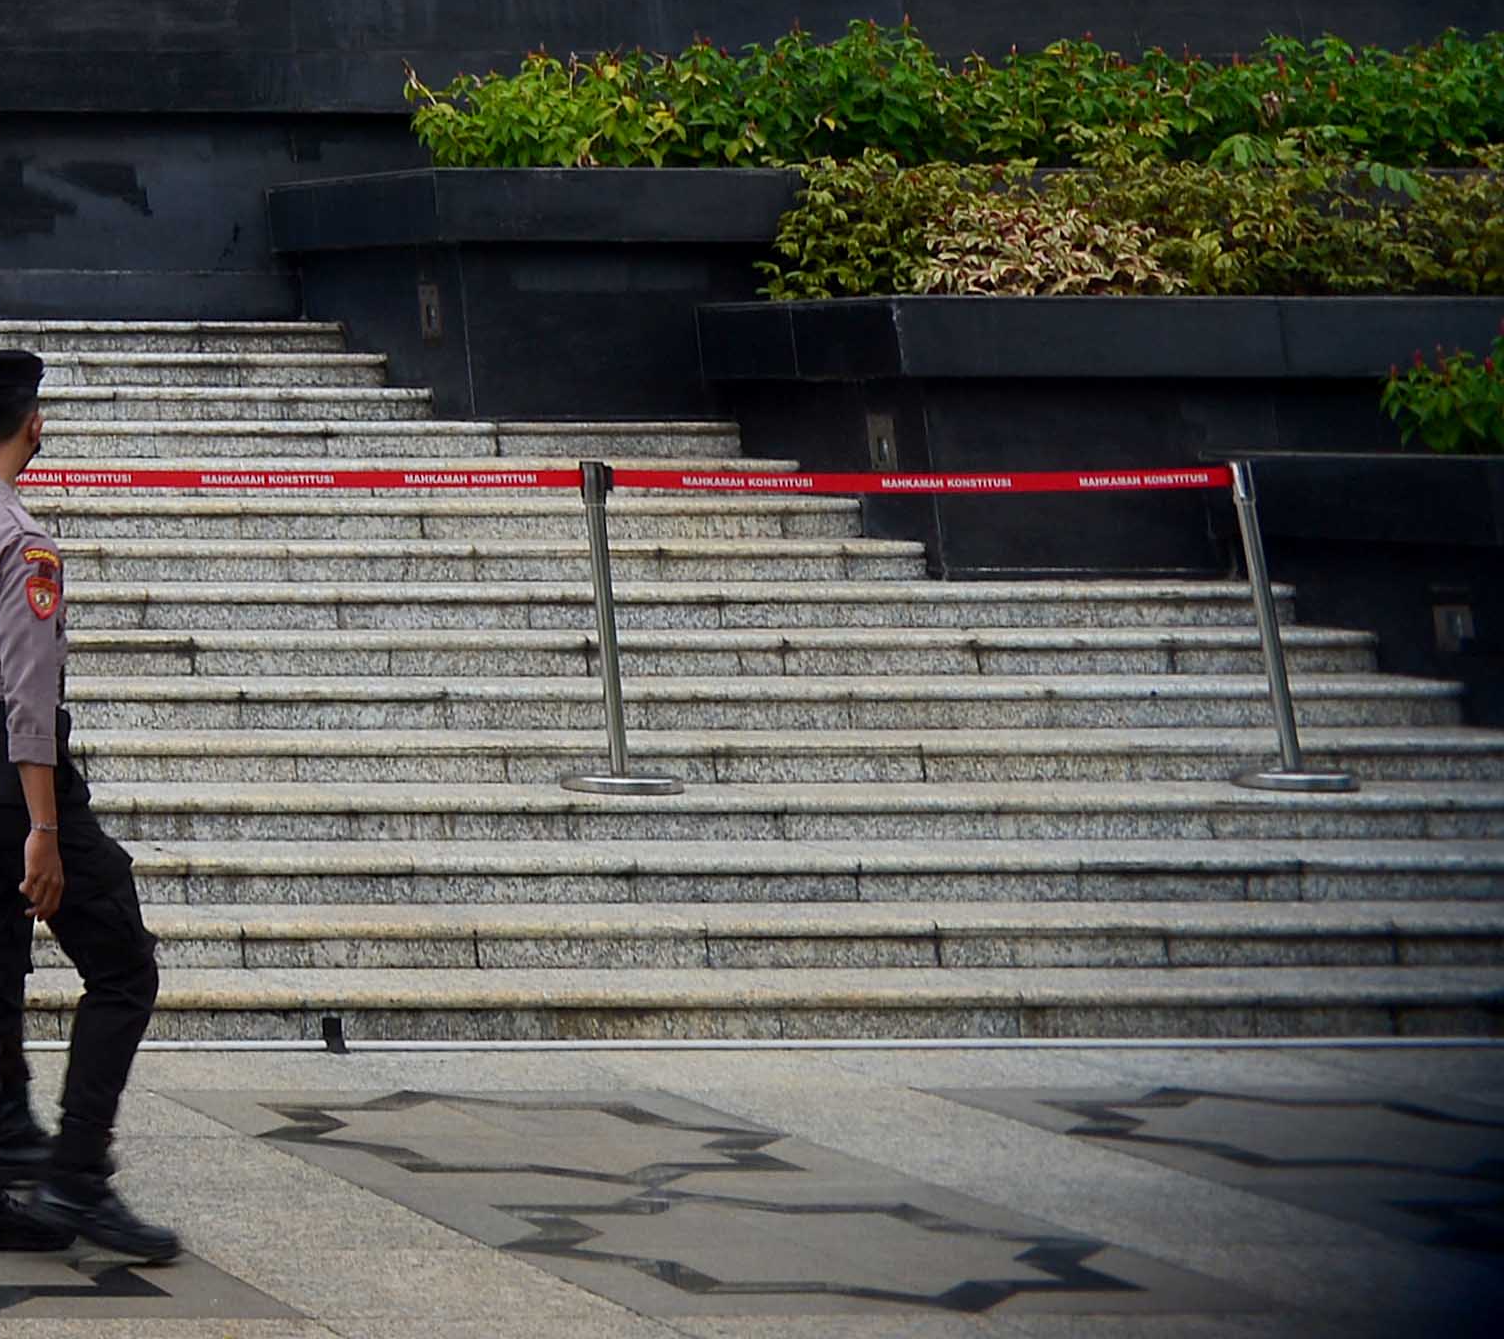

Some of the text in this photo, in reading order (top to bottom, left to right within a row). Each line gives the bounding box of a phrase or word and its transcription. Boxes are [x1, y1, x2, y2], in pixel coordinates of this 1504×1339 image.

[16, 474, 132, 484] HKAMAH KONSTITUSI
[201, 474, 334, 484] MAHKAMAH KONSTITUSI
[404, 474, 538, 484] MAHKAMAH KONSTITUSI
[682, 477, 813, 488] MAHKAMAH KONSTITUSI
[881, 478, 1012, 488] MAHKAMAH KONSTITUSI
[1079, 474, 1208, 487] MAHKAMAH KONSTITUSI
